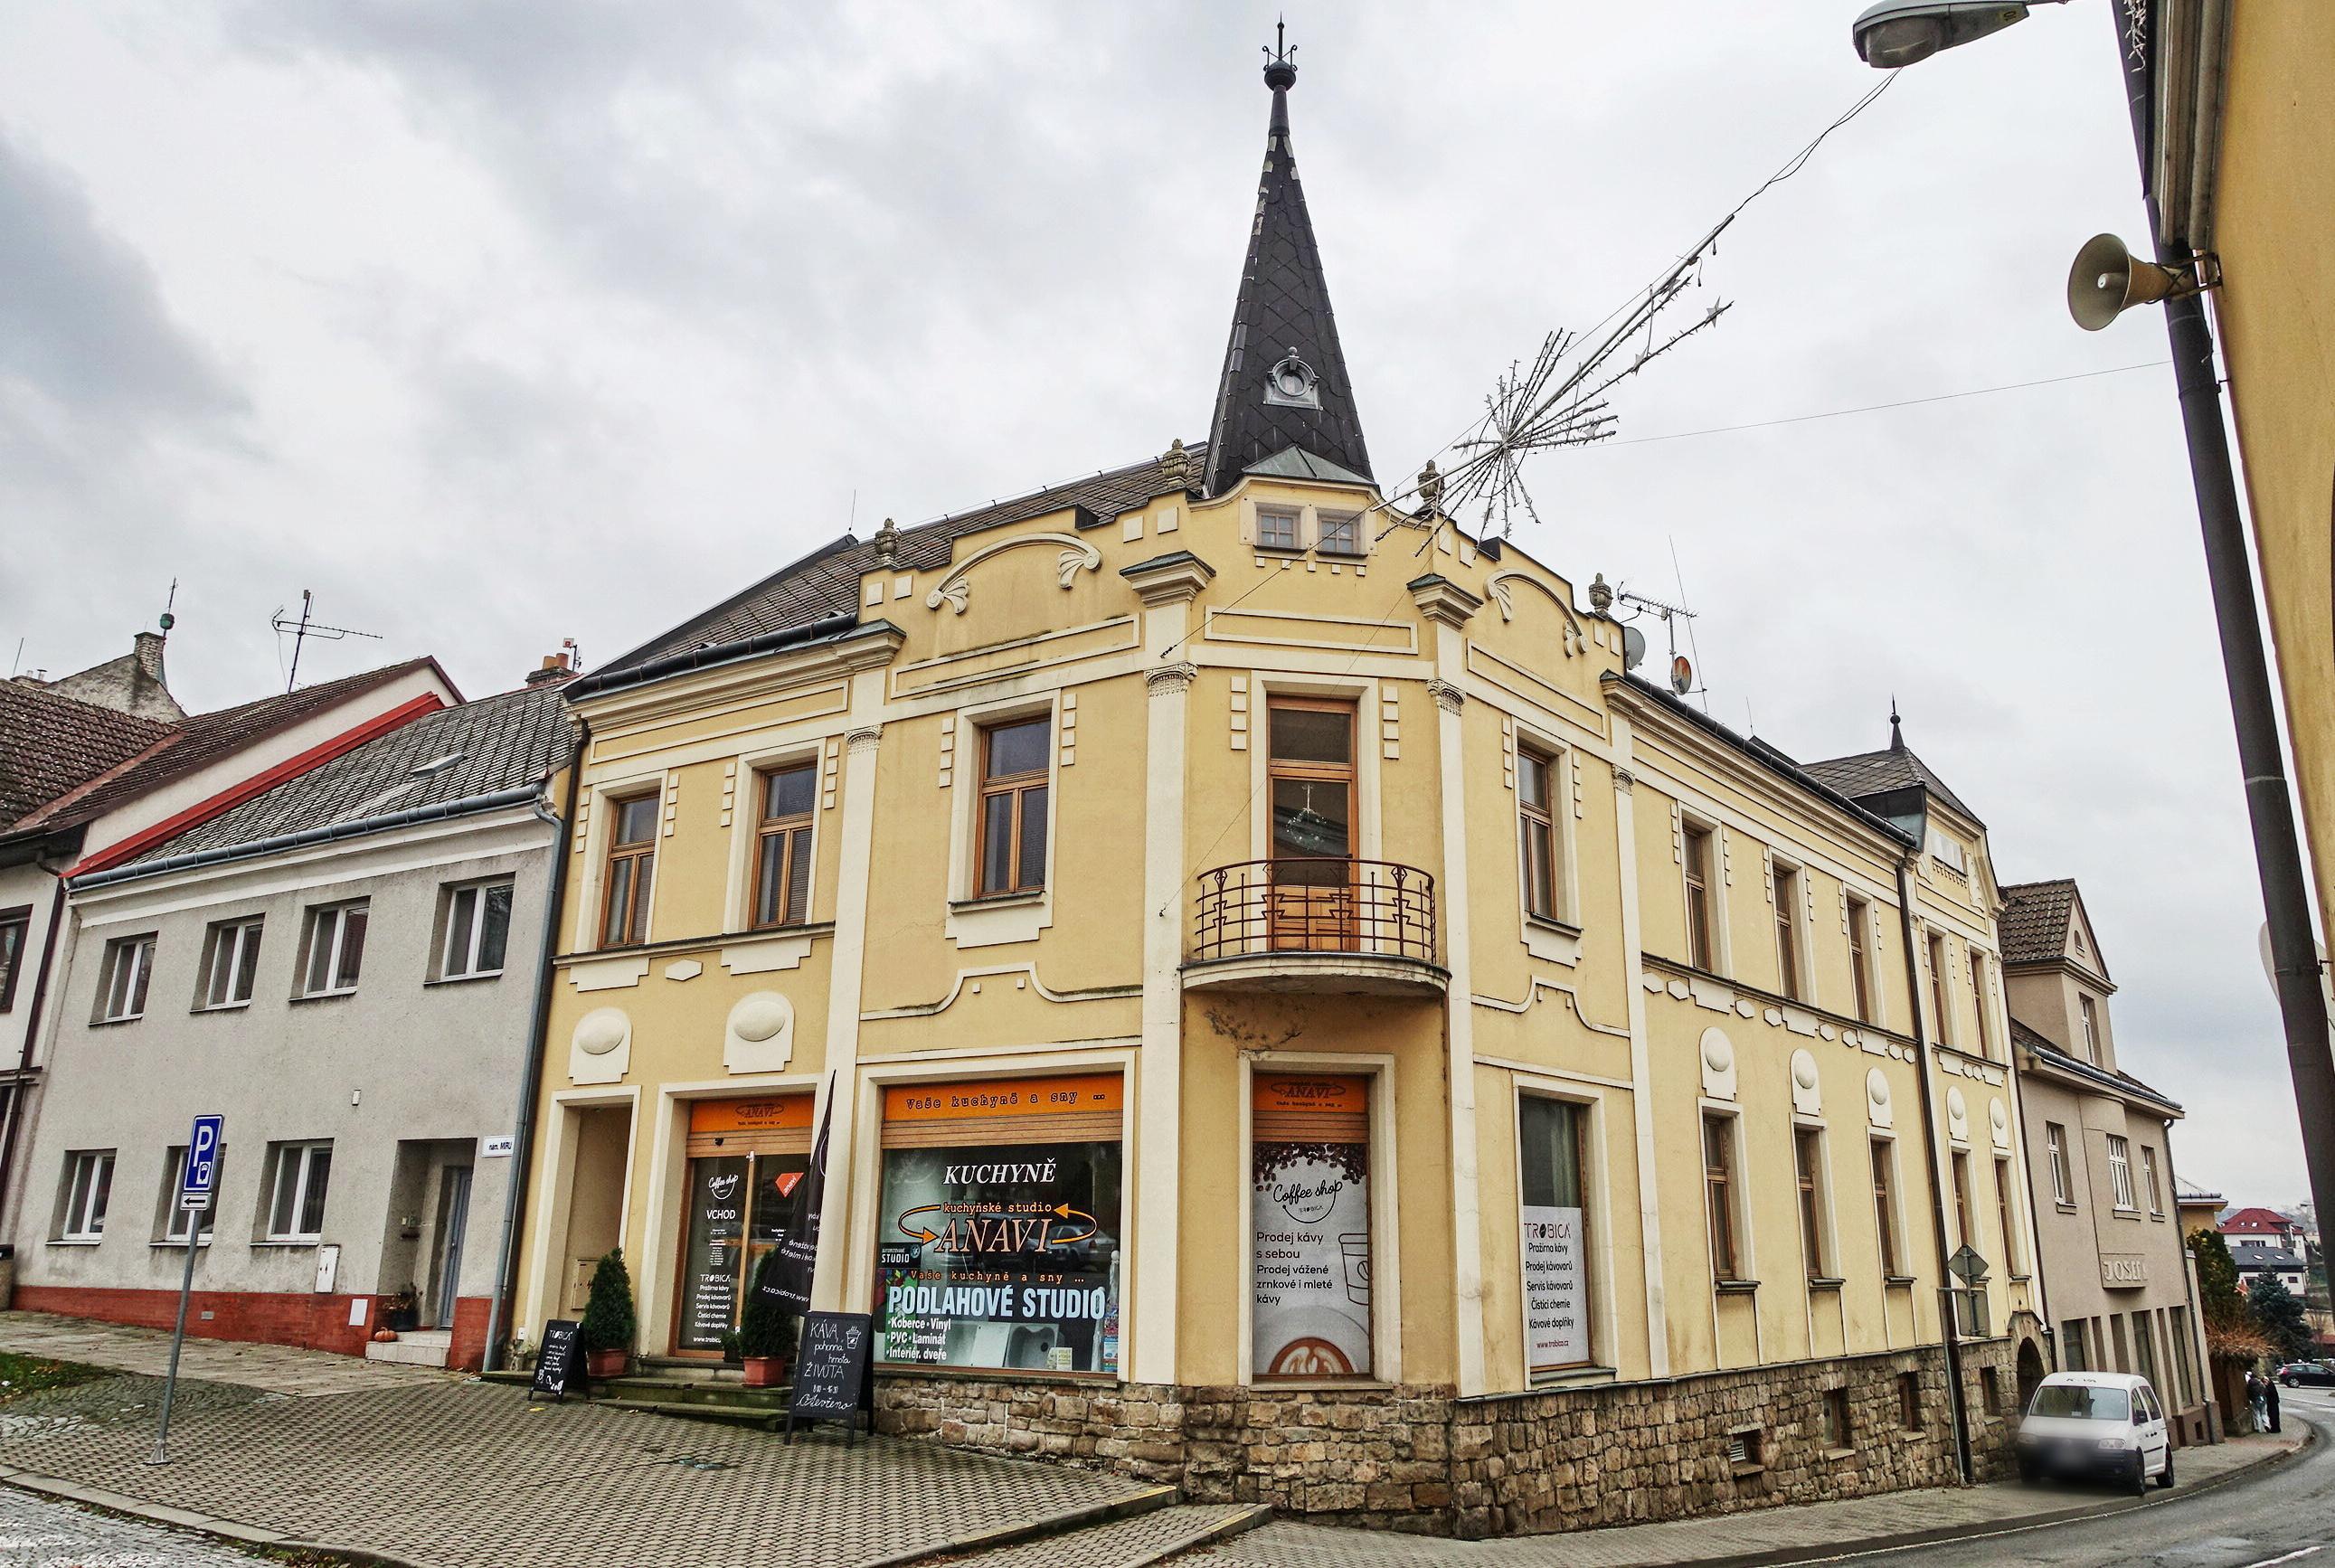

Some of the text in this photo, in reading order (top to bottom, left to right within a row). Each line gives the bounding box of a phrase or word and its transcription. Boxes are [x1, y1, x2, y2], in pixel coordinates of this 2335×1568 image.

[906, 1097, 941, 1110] Vaše
[951, 1092, 1018, 1108] kuchyně
[1030, 1094, 1038, 1103] a
[1050, 1091, 1077, 1104] sny
[193, 1125, 213, 1167] P
[942, 1157, 1057, 1185] KUCHYNĚ
[708, 1176, 725, 1190] Coffee
[1273, 1180, 1343, 1204] Coffee shop
[706, 1209, 736, 1220] VCHOD
[943, 1201, 1052, 1215] kuchyňské studio
[934, 1218, 1053, 1253] ANAVI
[1256, 1232, 1323, 1245] Prodej kávy
[1265, 1249, 1300, 1259] sebou
[1555, 1242, 1568, 1255] kávy
[882, 1253, 910, 1263] STUDIO
[1257, 1265, 1329, 1276] Prodej vážené
[1526, 1261, 1573, 1274] Prodej kávovarů
[910, 1270, 941, 1281] Vaše
[951, 1270, 1009, 1283] kuchyně
[1021, 1273, 1027, 1281] a
[1040, 1273, 1064, 1285] sny
[1256, 1280, 1296, 1289] zrnkové
[1303, 1280, 1333, 1289] mleté
[1527, 1280, 1574, 1291] Servis kávovarů
[889, 1283, 1105, 1319] PODLAHOVÉ STUDIO
[1256, 1295, 1281, 1306] kávy
[1550, 1299, 1570, 1308] chemie
[891, 1317, 951, 1332] Koberce Vinyl
[1529, 1317, 1574, 1330] Kávové doplňky
[890, 1331, 947, 1346] PVC Laminát
[889, 1346, 947, 1360] Interiér. dveře
[804, 1361, 845, 1380] ŽIVOTA
[796, 1393, 853, 1410] Otevřeno
